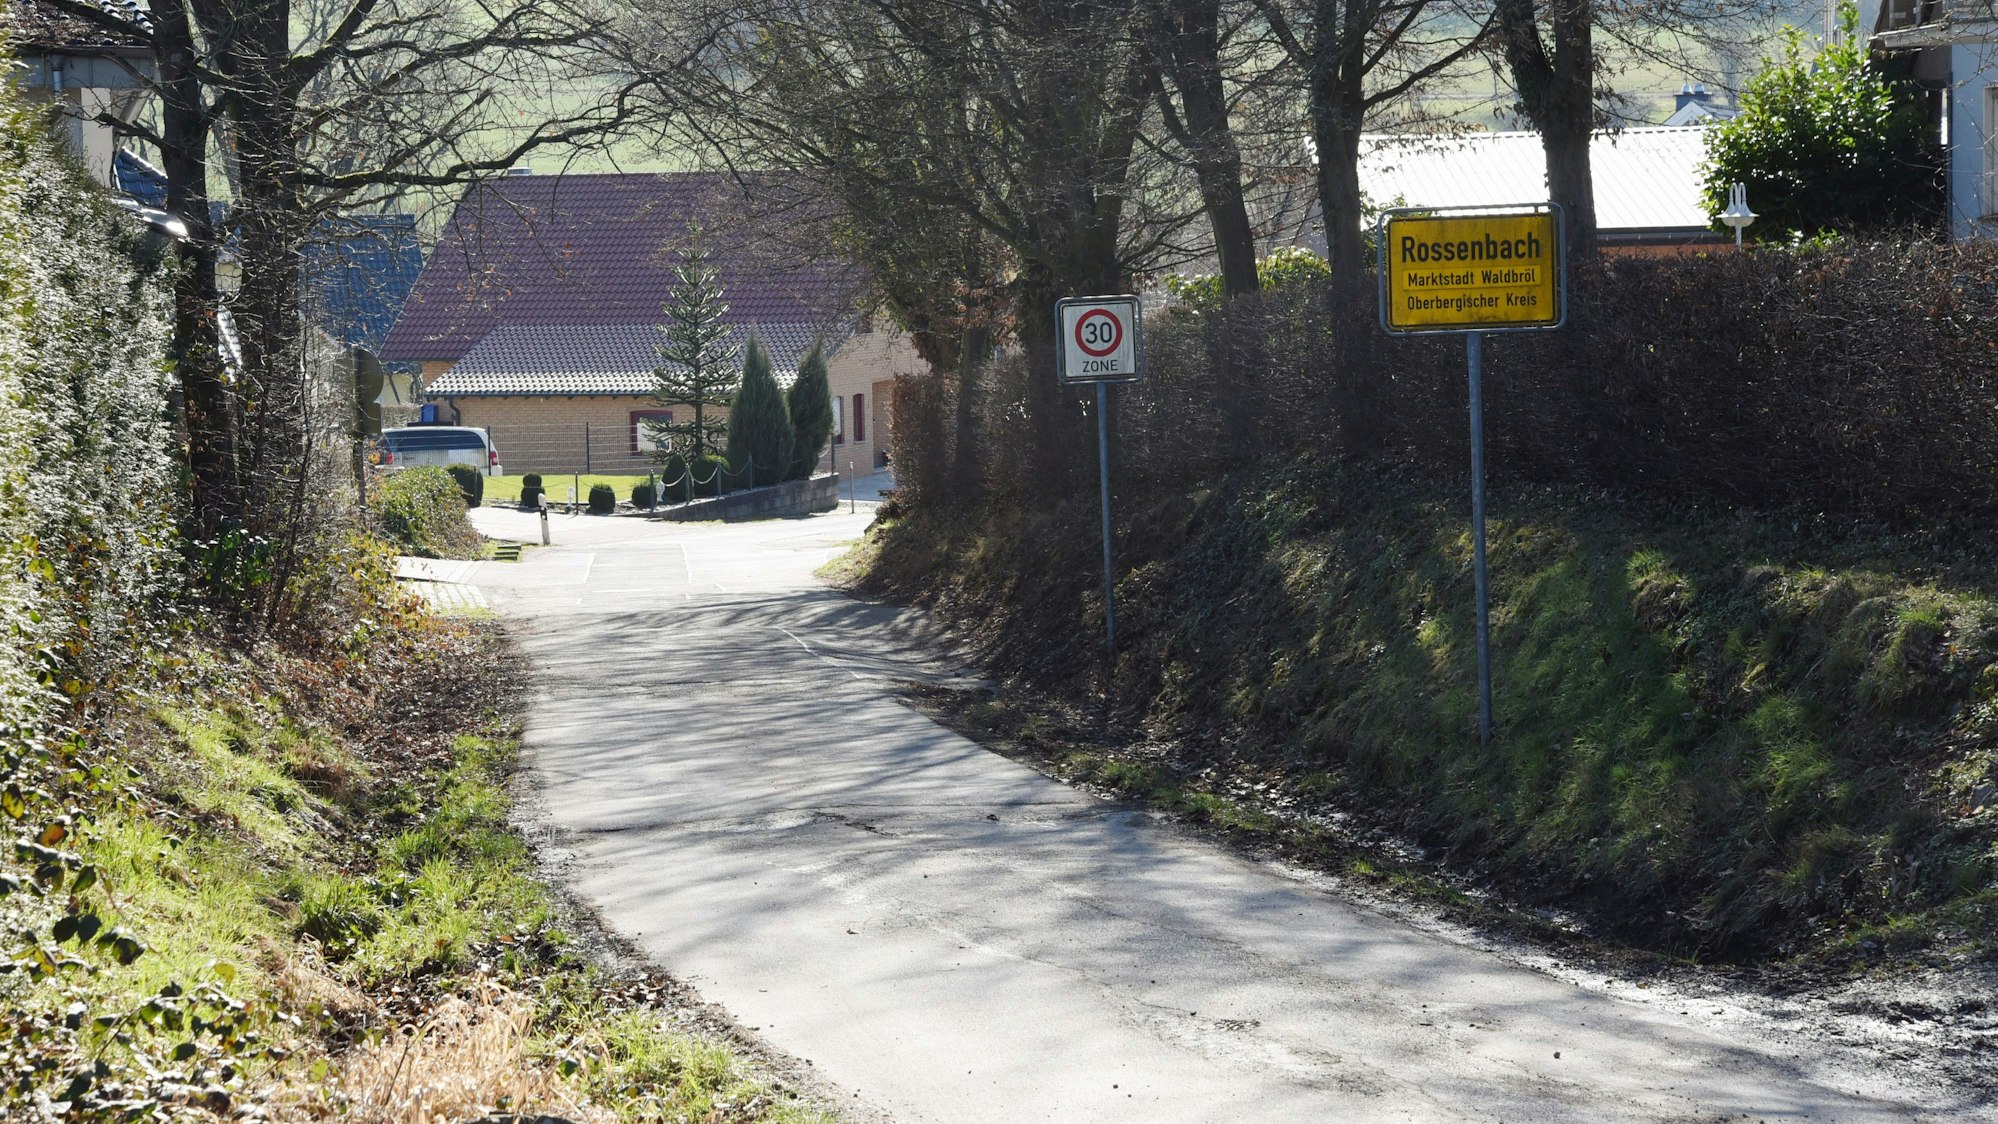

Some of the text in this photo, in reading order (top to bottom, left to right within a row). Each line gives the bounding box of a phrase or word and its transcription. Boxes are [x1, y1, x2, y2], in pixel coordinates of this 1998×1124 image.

[1402, 232, 1540, 263] Rossenbach
[1408, 268, 1535, 287] Marktstadt Waldbröl
[1407, 291, 1537, 312] Oberbergischer Kreis
[1085, 322, 1112, 344] 30
[1082, 359, 1118, 373] ZONE
